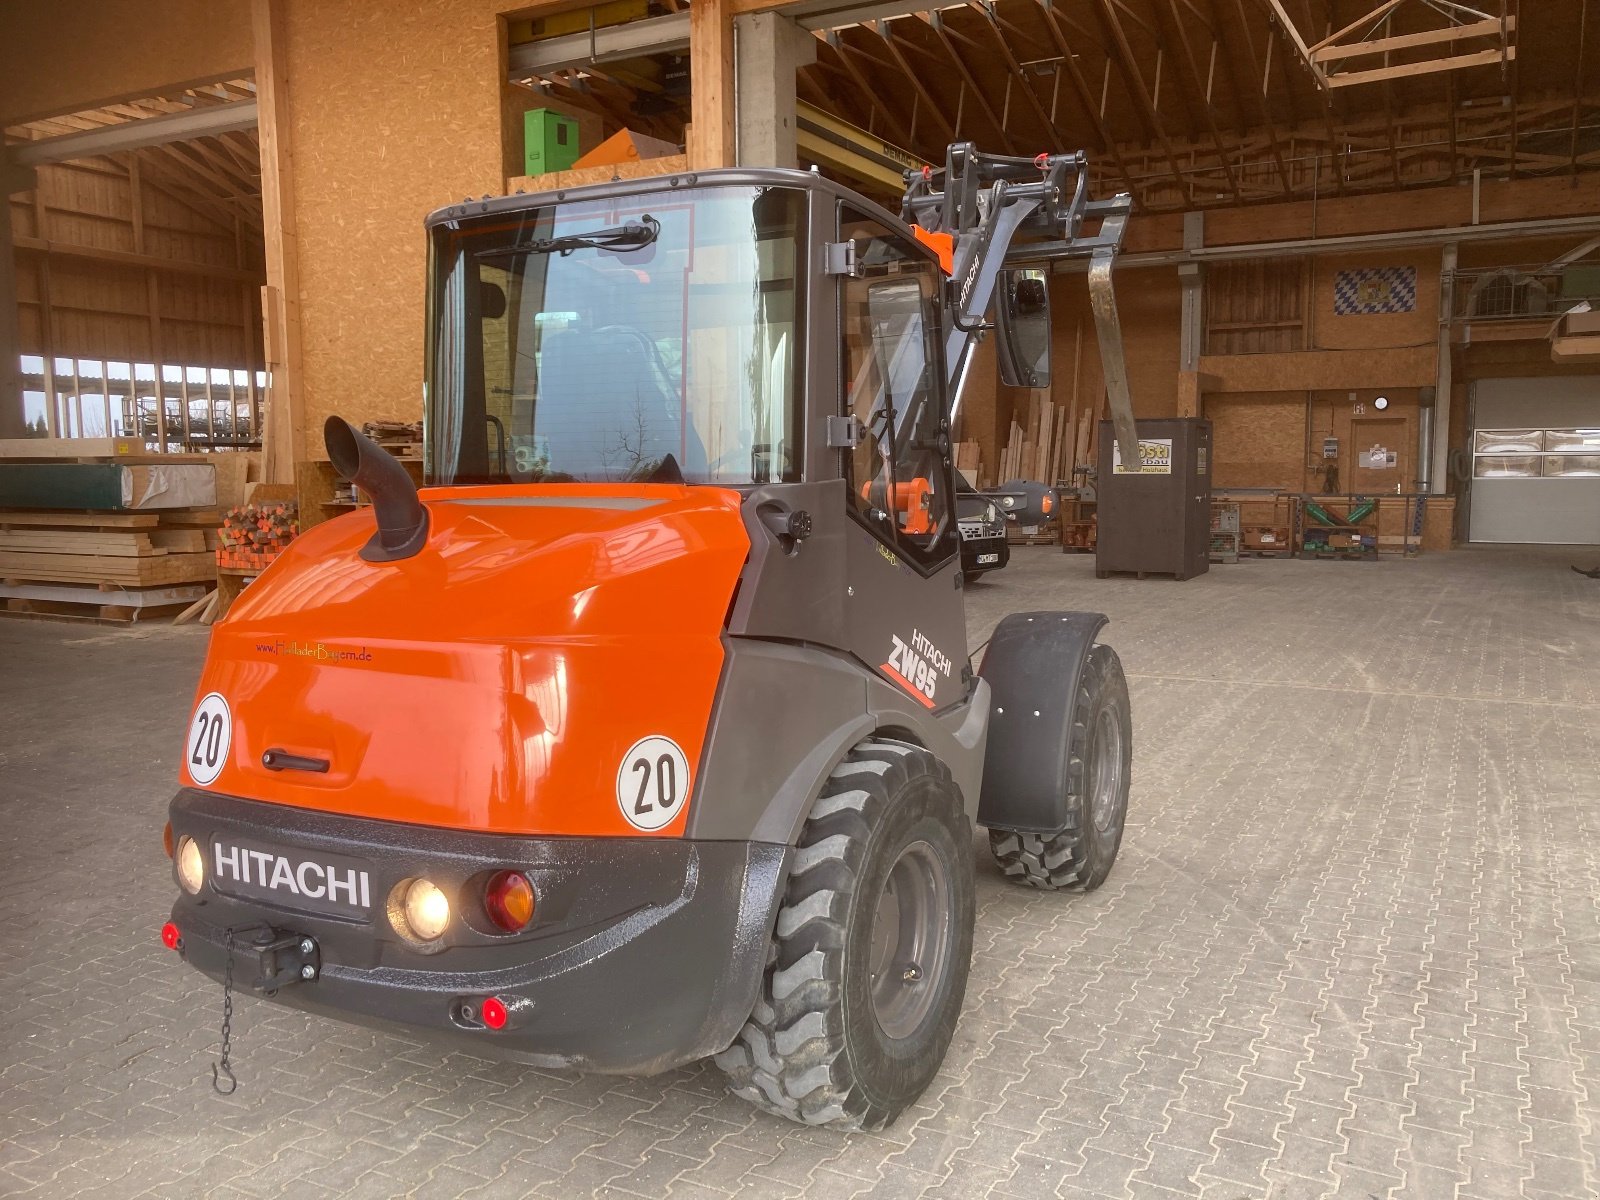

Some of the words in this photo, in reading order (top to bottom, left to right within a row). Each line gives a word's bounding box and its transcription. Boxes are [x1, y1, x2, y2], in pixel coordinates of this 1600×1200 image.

[960, 254, 980, 309] HITACHI
[888, 634, 938, 699] ZW95
[911, 628, 952, 678] HITACHI
[191, 711, 223, 768] 20
[632, 753, 676, 816] 20
[214, 842, 371, 908] HITACHI
